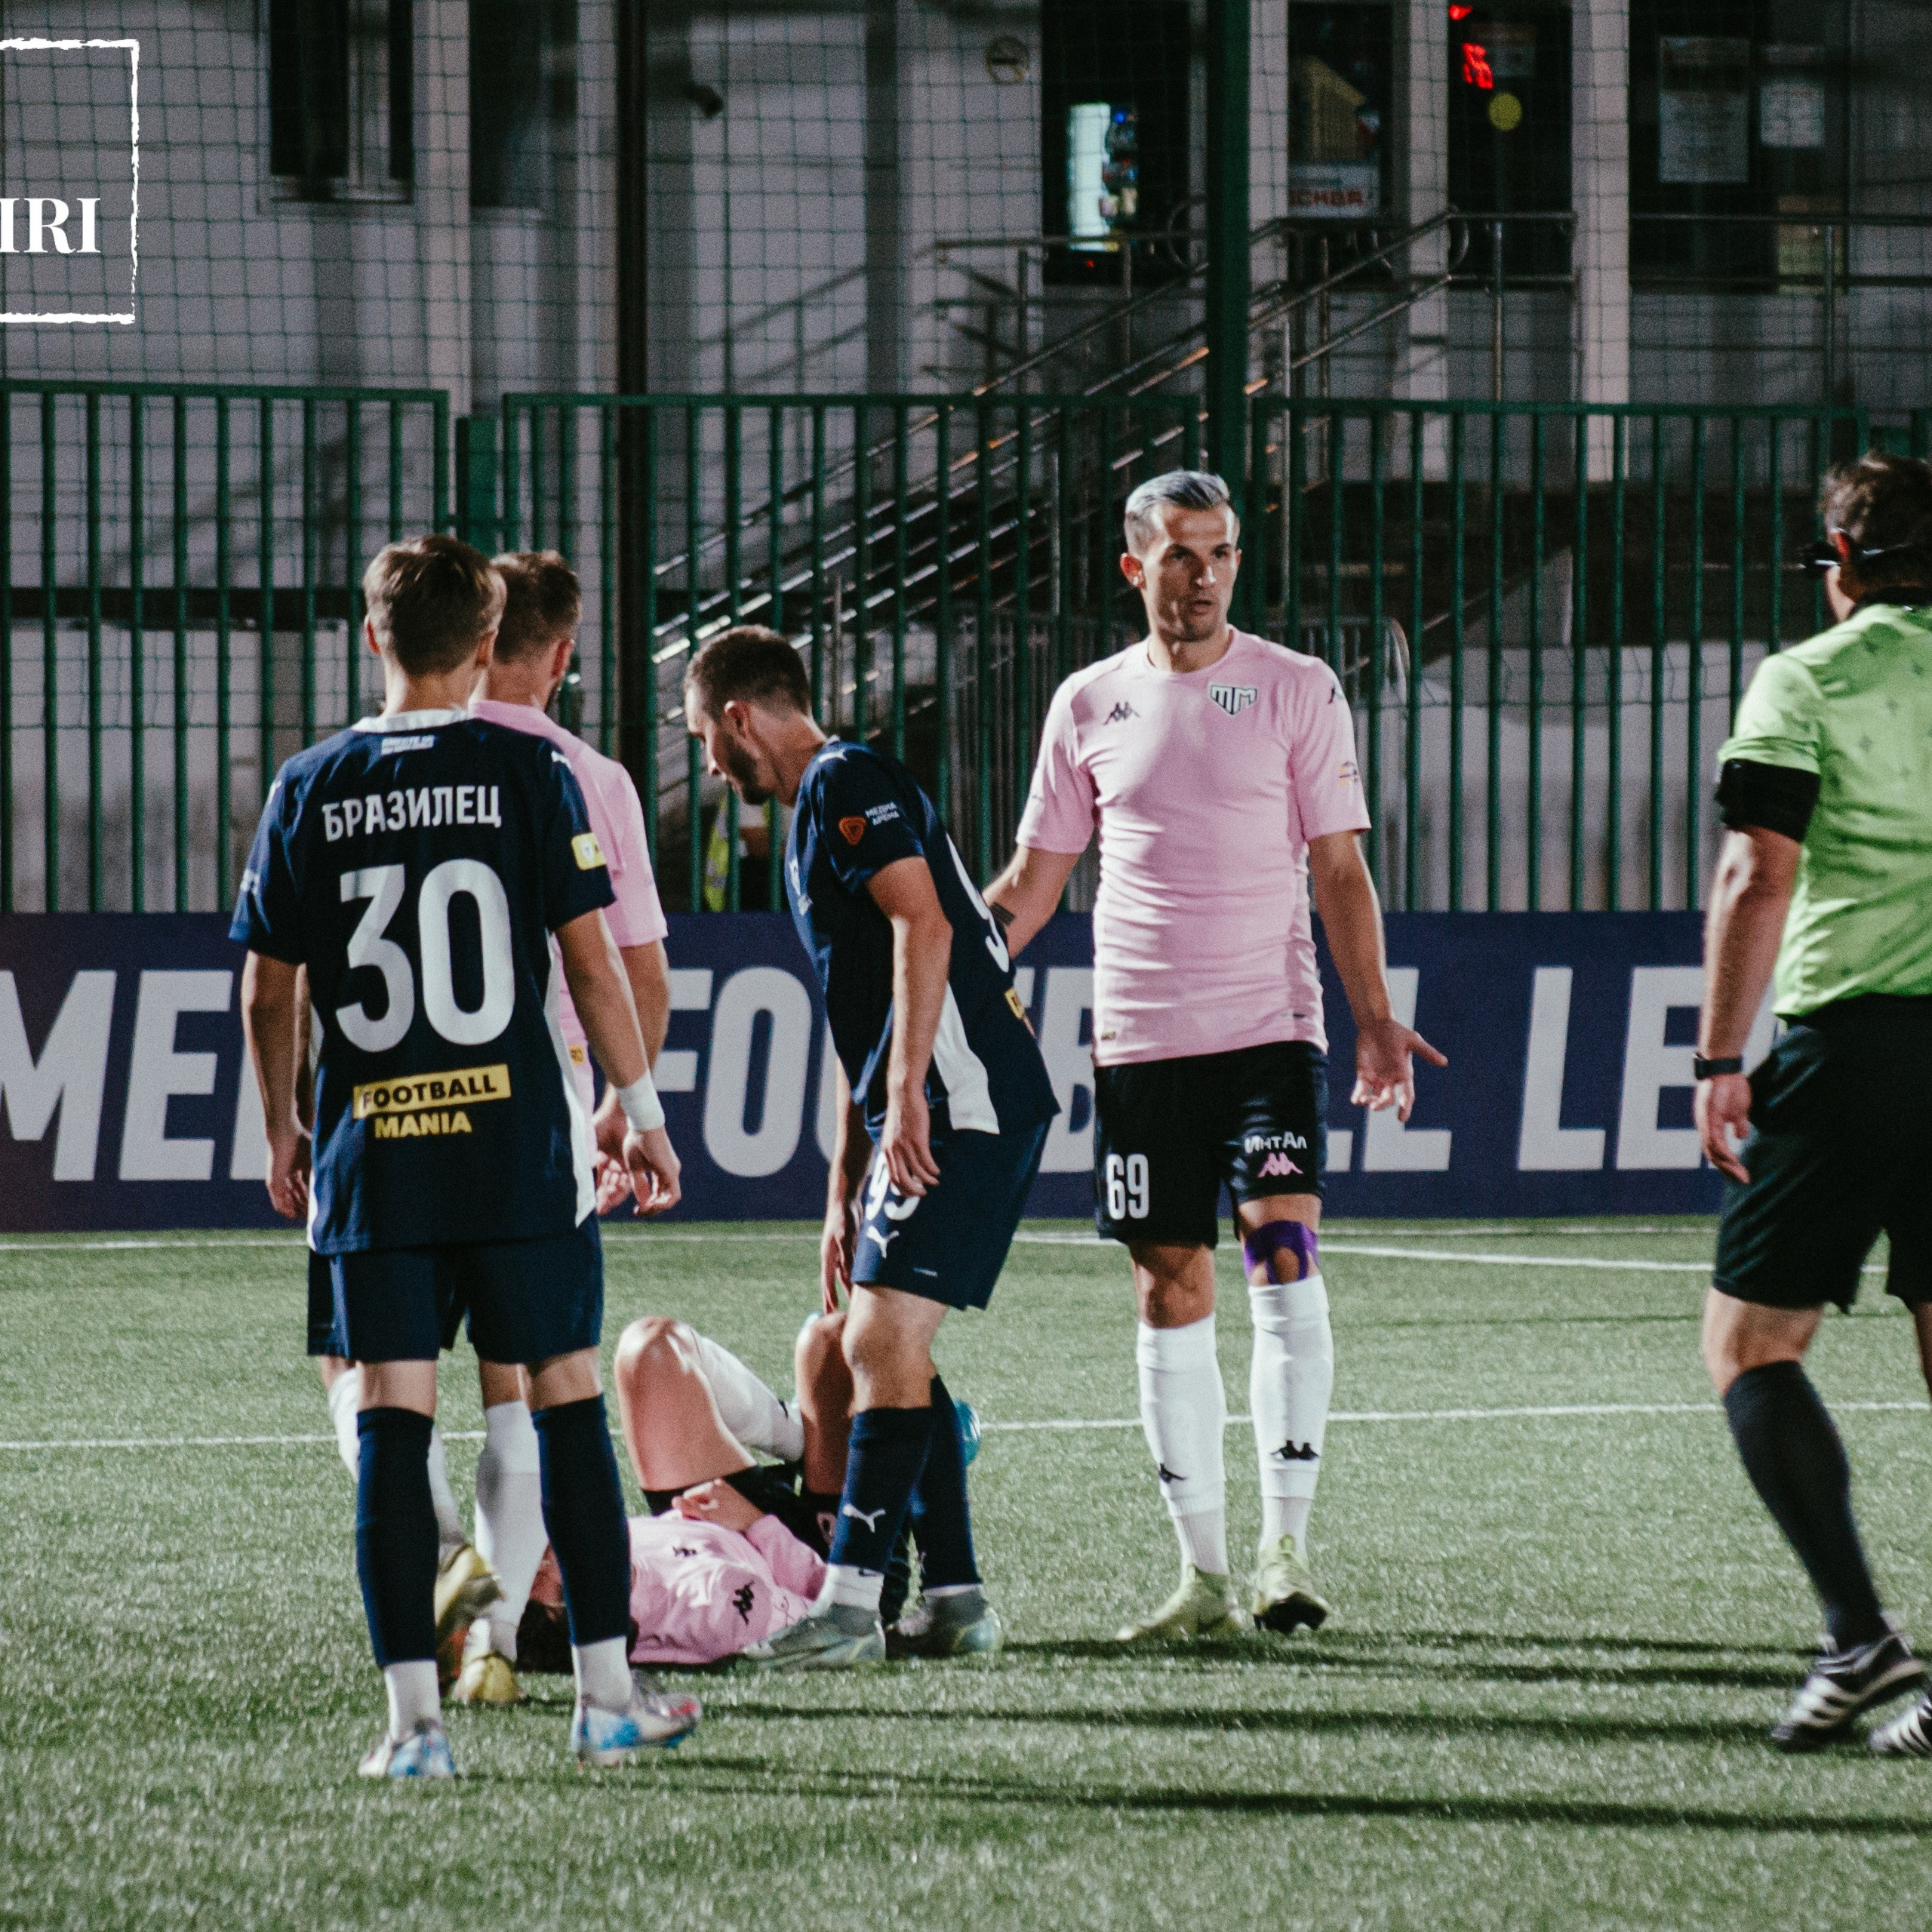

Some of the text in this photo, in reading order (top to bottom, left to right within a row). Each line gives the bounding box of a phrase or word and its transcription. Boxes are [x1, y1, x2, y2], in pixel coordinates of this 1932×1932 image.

[322, 786, 501, 842] БРАЗИЛЕЦ
[336, 859, 515, 1052] 30
[362, 1073, 497, 1110] FOOTBALL
[374, 1110, 473, 1140] MANIA
[1106, 1153, 1149, 1220] 69
